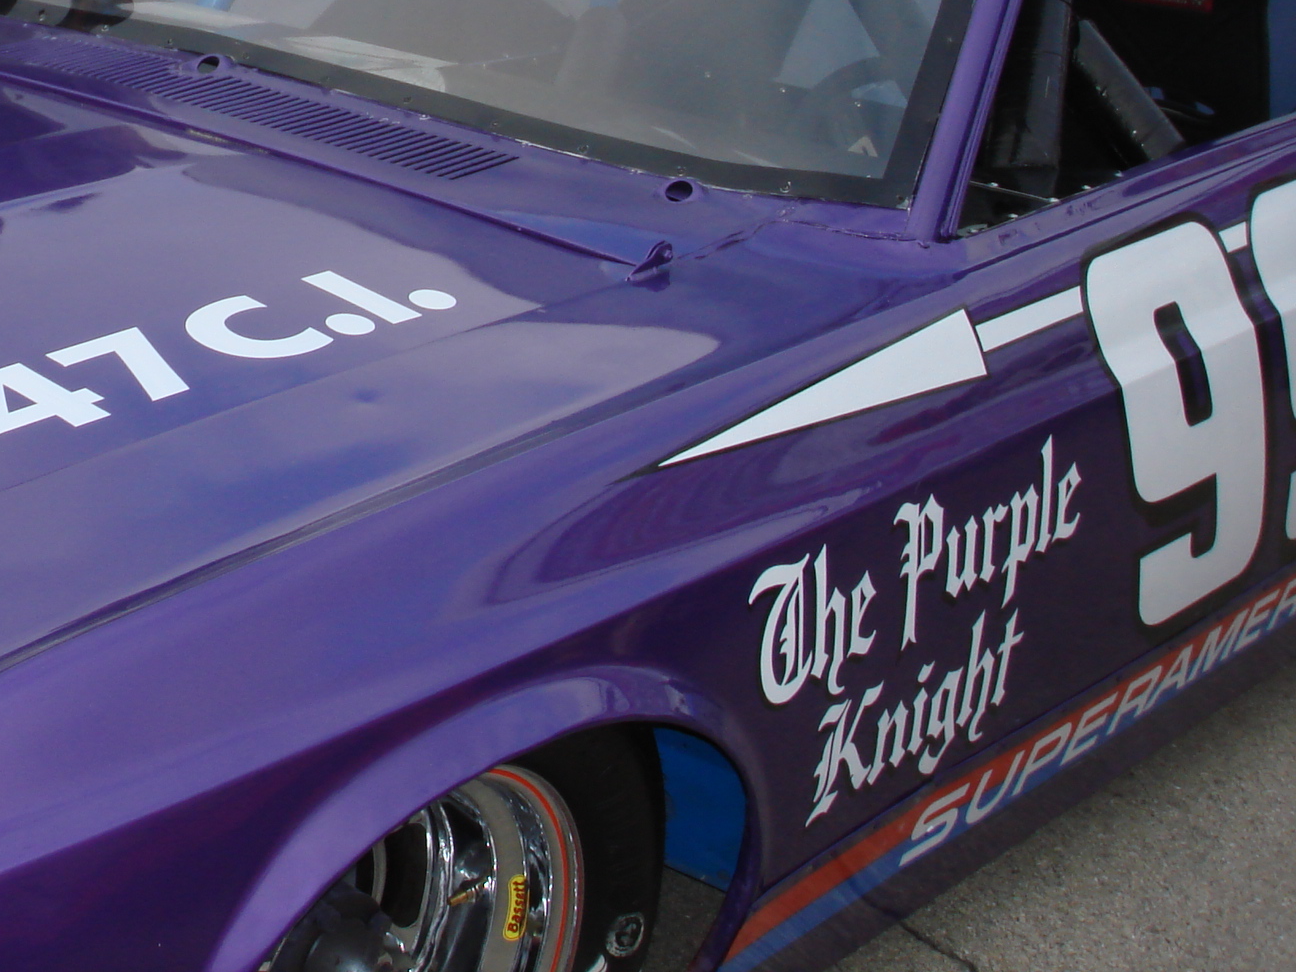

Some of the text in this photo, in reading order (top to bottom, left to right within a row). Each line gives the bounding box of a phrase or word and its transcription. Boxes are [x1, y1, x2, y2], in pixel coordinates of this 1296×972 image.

[184, 269, 458, 360] C.I.
[747, 433, 1082, 705] The Purple
[805, 607, 1025, 828] Knight
[506, 878, 527, 935] Bassett
